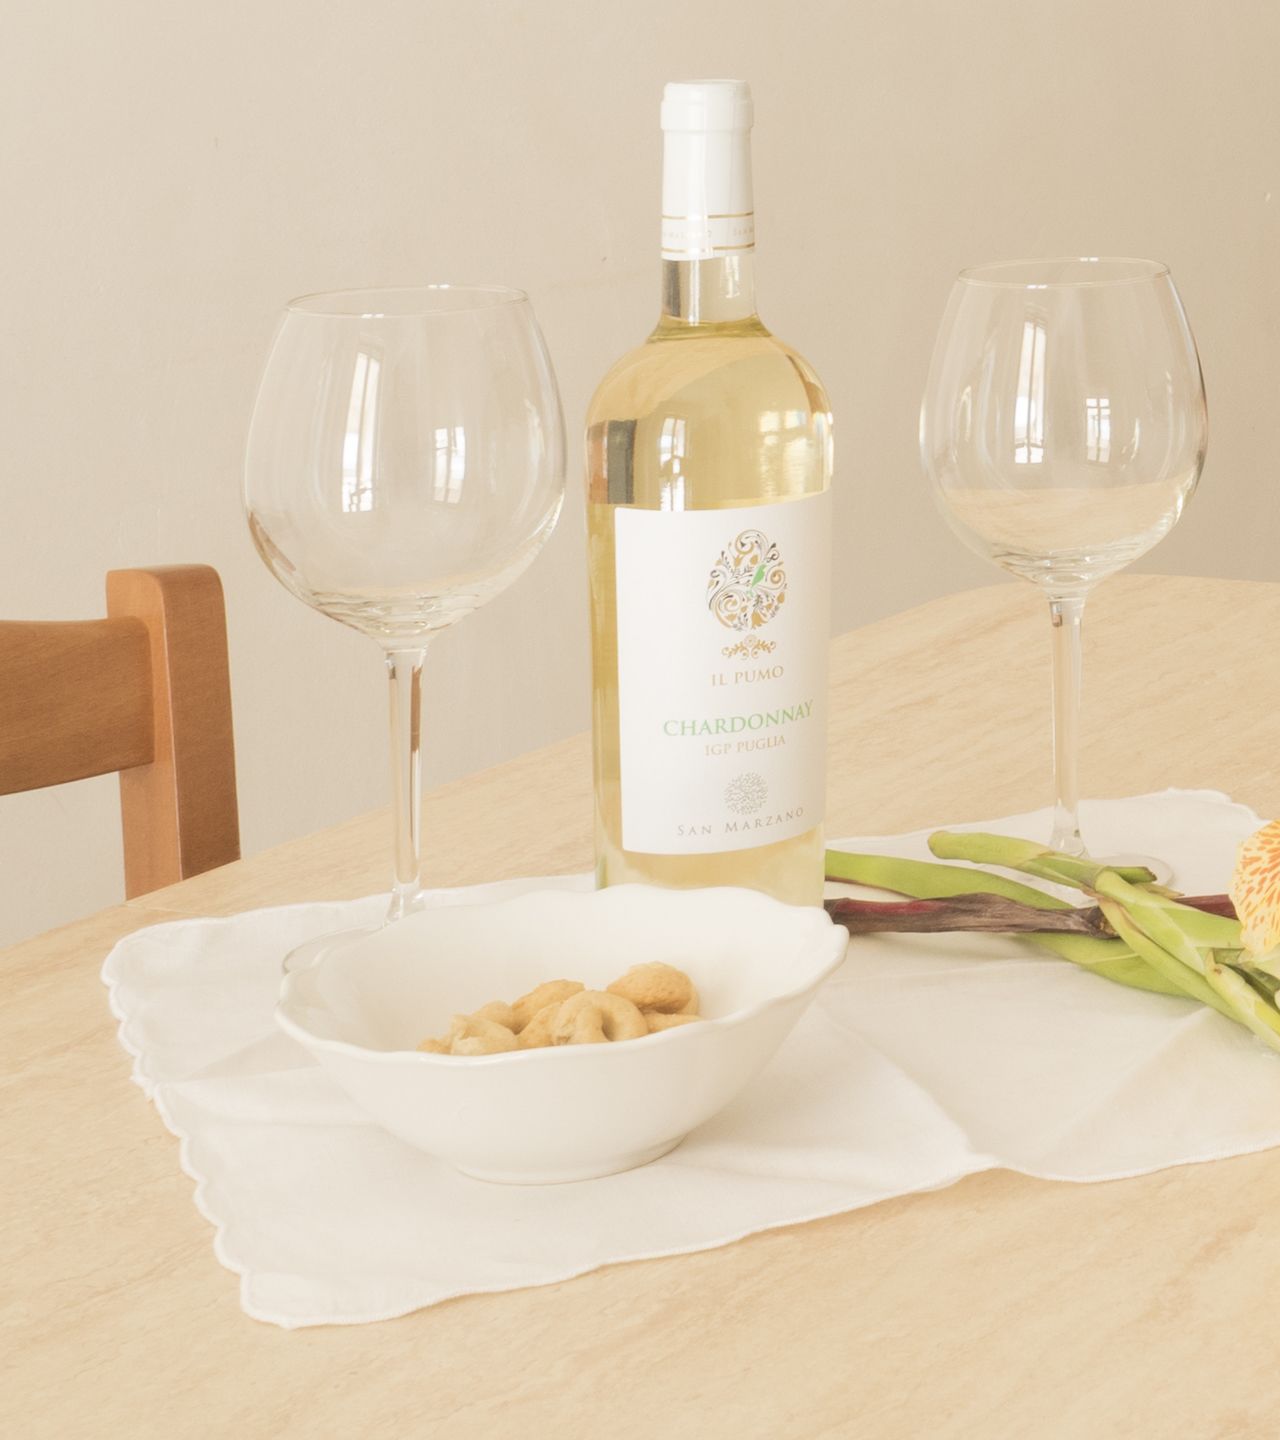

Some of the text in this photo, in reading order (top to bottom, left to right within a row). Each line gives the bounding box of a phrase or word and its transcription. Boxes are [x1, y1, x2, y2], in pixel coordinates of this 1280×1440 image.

[711, 665, 785, 687] IL PUMO
[663, 699, 814, 737] CHARDONNAY
[704, 735, 787, 757] IGP PUGLIA
[724, 807, 805, 834] MARZANO
